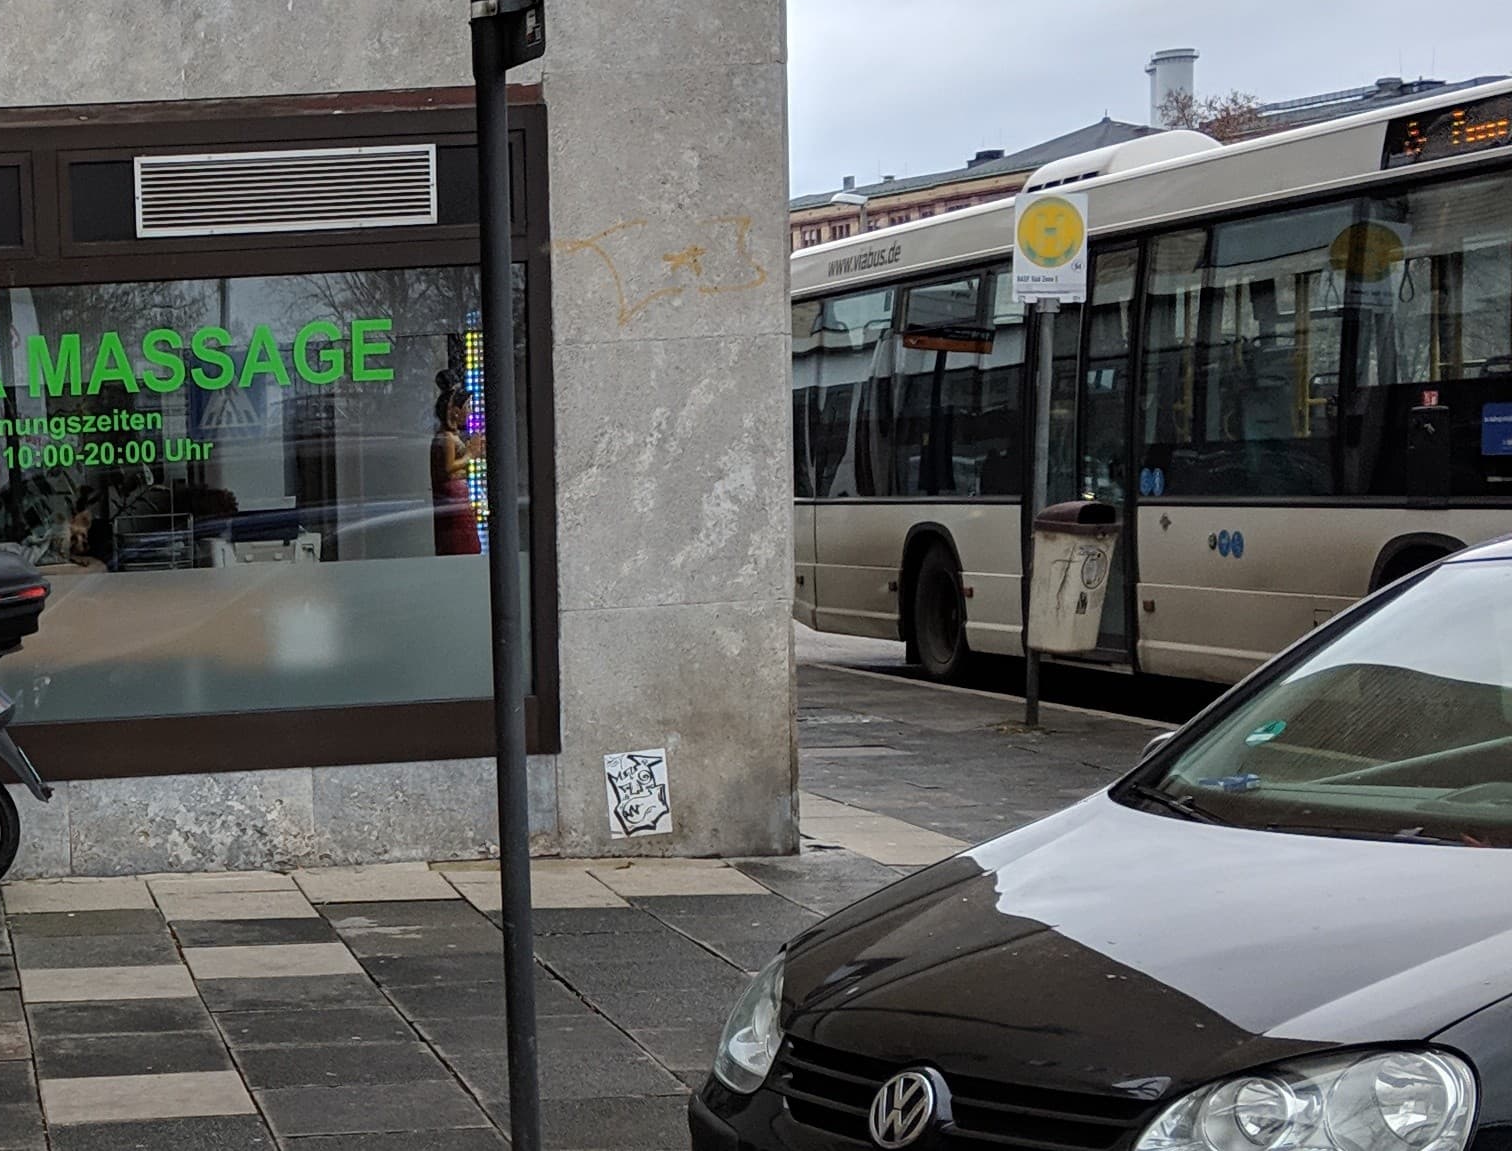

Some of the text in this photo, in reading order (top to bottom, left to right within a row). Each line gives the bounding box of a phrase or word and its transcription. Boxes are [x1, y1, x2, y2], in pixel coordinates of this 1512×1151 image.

[828, 239, 902, 277] www.viabus.de
[27, 319, 395, 398] MASSAGE
[3, 440, 156, 472] 10:00-20:00
[165, 438, 214, 463] Uhr
